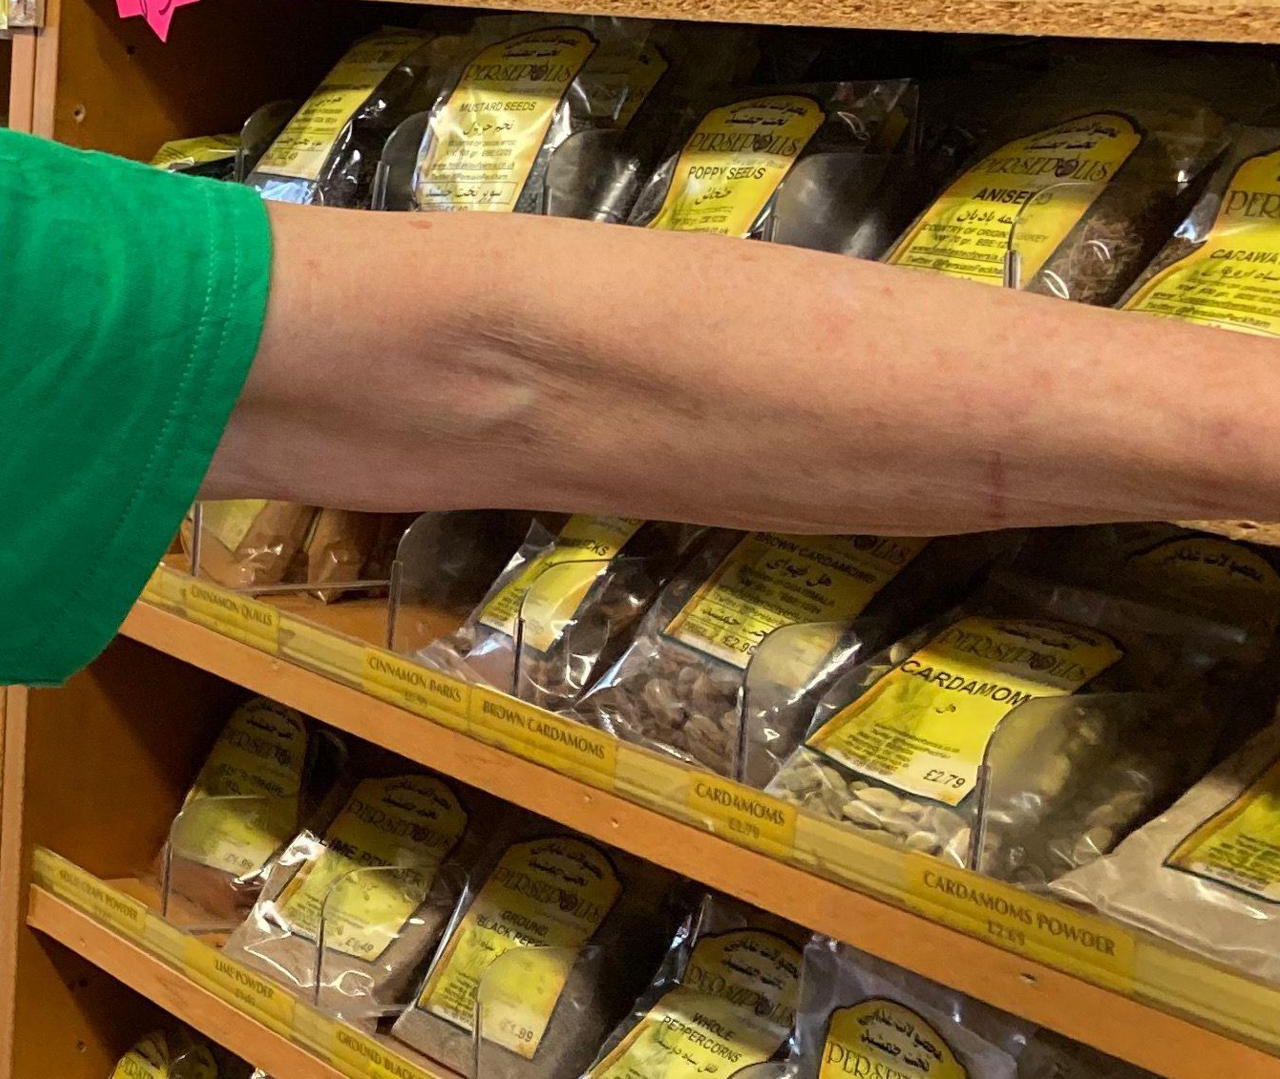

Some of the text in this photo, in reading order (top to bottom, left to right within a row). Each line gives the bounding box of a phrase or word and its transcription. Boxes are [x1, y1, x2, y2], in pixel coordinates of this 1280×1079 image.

[464, 63, 573, 83] PERSEPOLIS
[458, 101, 537, 113] MUSTARD SEEDS
[689, 132, 800, 156] PERSEPOLIS
[688, 165, 766, 180] POPPY SEEDS
[983, 157, 1109, 182] PERSEPOLIS
[1209, 248, 1280, 265] CARAWA
[190, 584, 274, 627] CINNAMON QUILLS
[367, 654, 428, 692] CINNAMON
[428, 676, 463, 704] BARKS
[482, 699, 607, 761] BROWN CARDAMOMS
[922, 769, 967, 790] £2.79
[694, 782, 787, 825] CARDAMOMS
[922, 870, 1117, 957] CARDAMOMS POWDER
[236, 971, 275, 999] POWDER
[661, 1014, 744, 1064] PEPPERCORNS
[692, 1011, 737, 1042] WHOLE
[336, 1031, 383, 1066] GROUND
